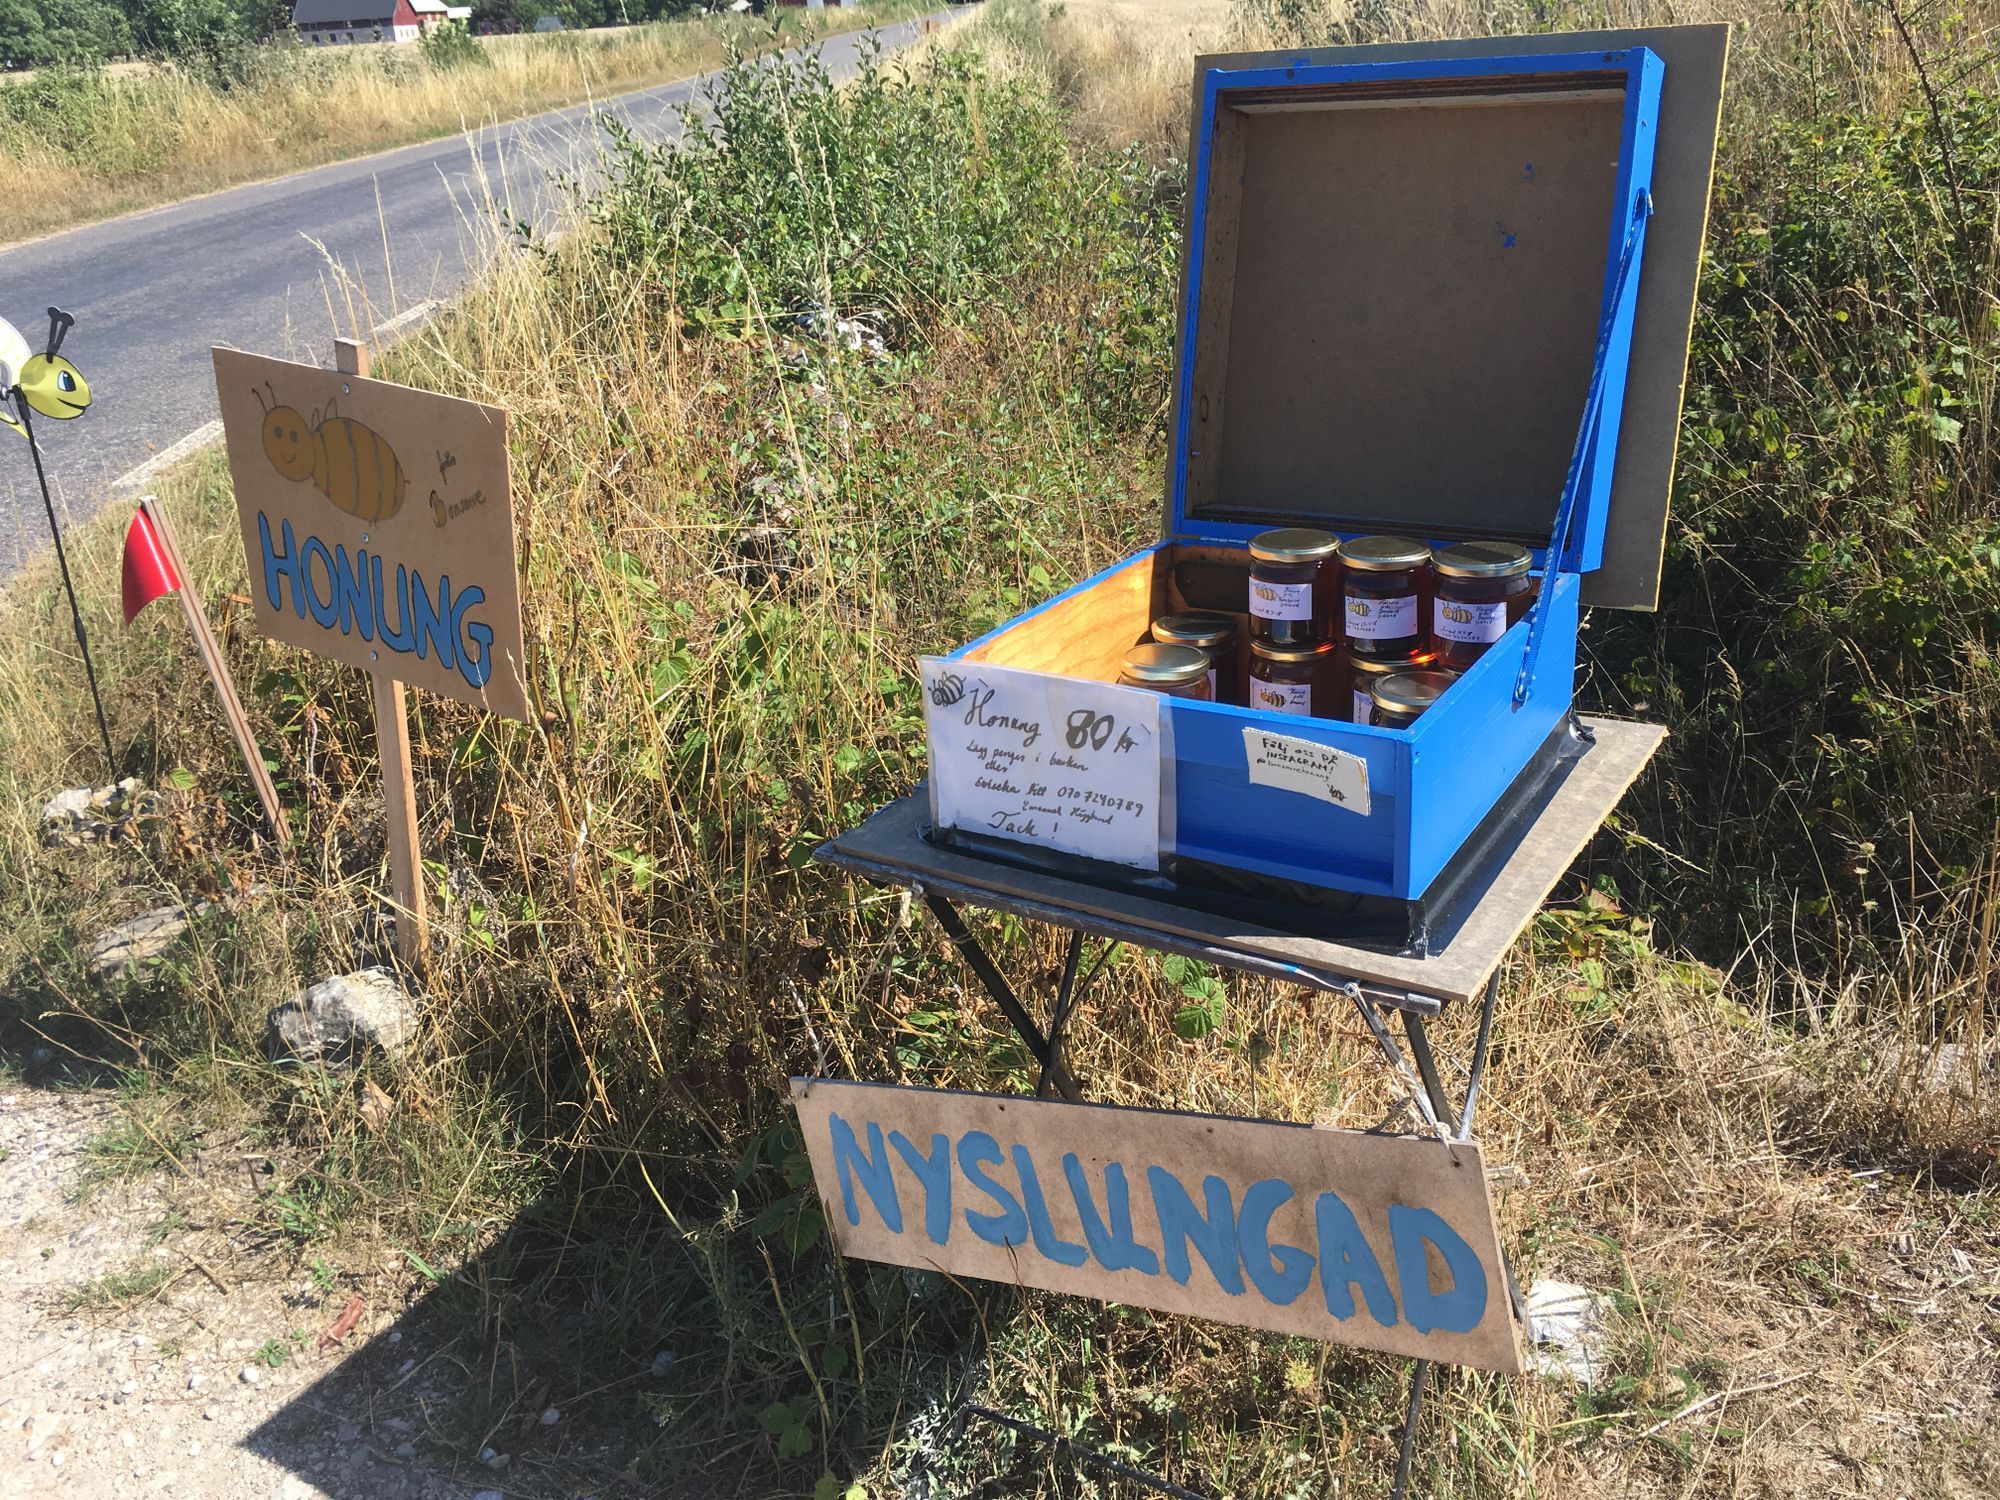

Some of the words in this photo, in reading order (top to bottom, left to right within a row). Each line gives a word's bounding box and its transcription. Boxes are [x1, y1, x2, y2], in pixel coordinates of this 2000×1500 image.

[258, 510, 493, 688] HONUNG
[964, 688, 1041, 747] Honung
[1066, 709, 1114, 751] 80
[1114, 726, 1139, 753] kr
[829, 1112, 1488, 1334] NYSLUNGAD
